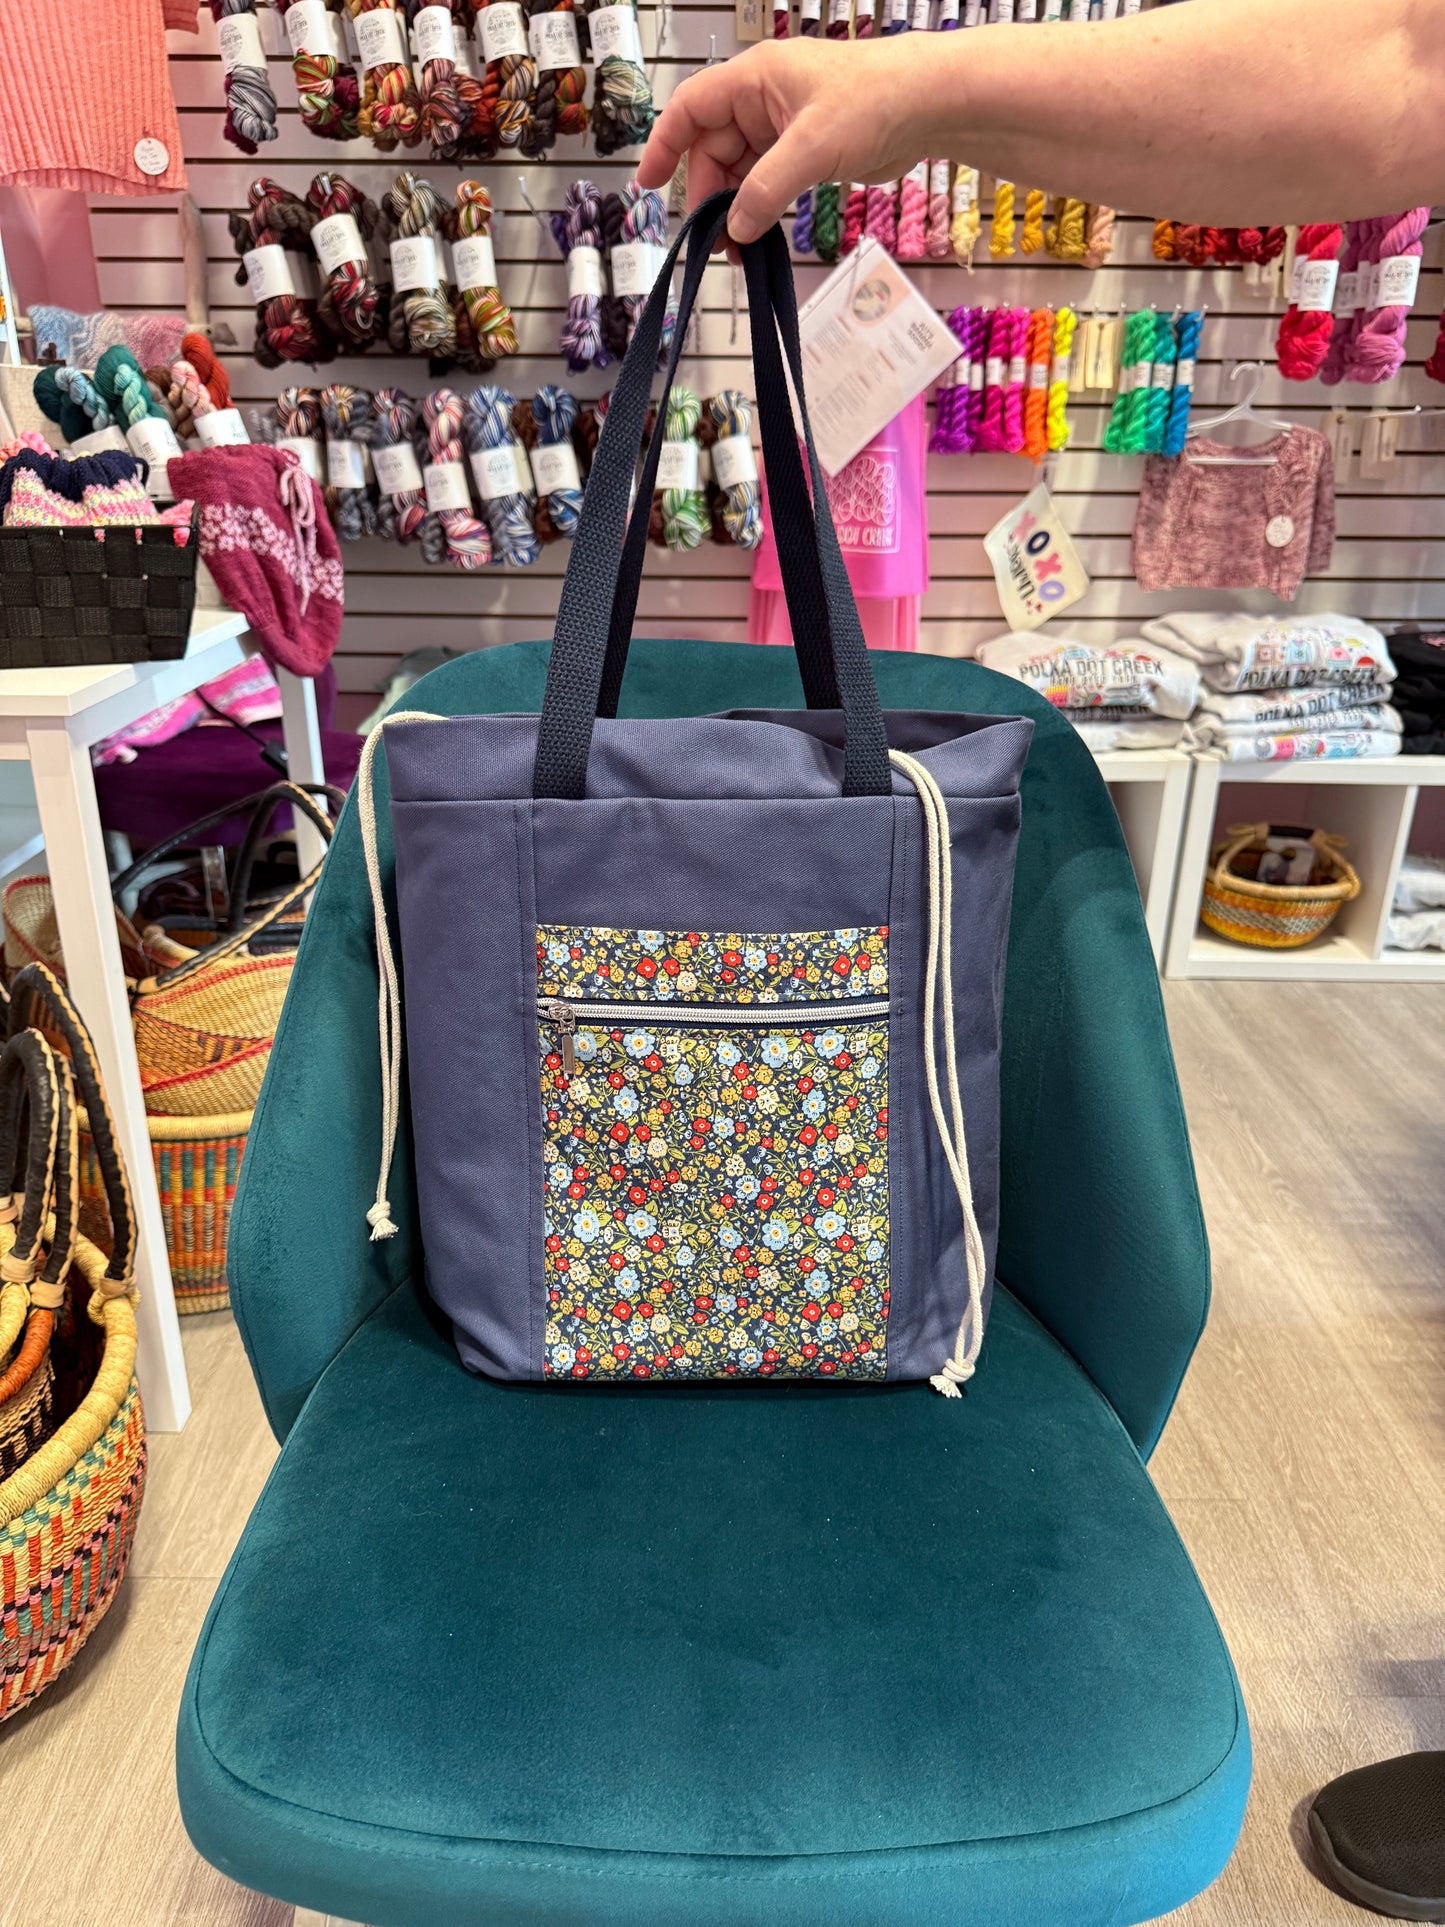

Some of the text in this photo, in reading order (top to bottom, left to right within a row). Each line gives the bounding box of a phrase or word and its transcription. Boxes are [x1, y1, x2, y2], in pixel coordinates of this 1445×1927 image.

[1019, 657, 1165, 679] POLKA DOT CREEK
